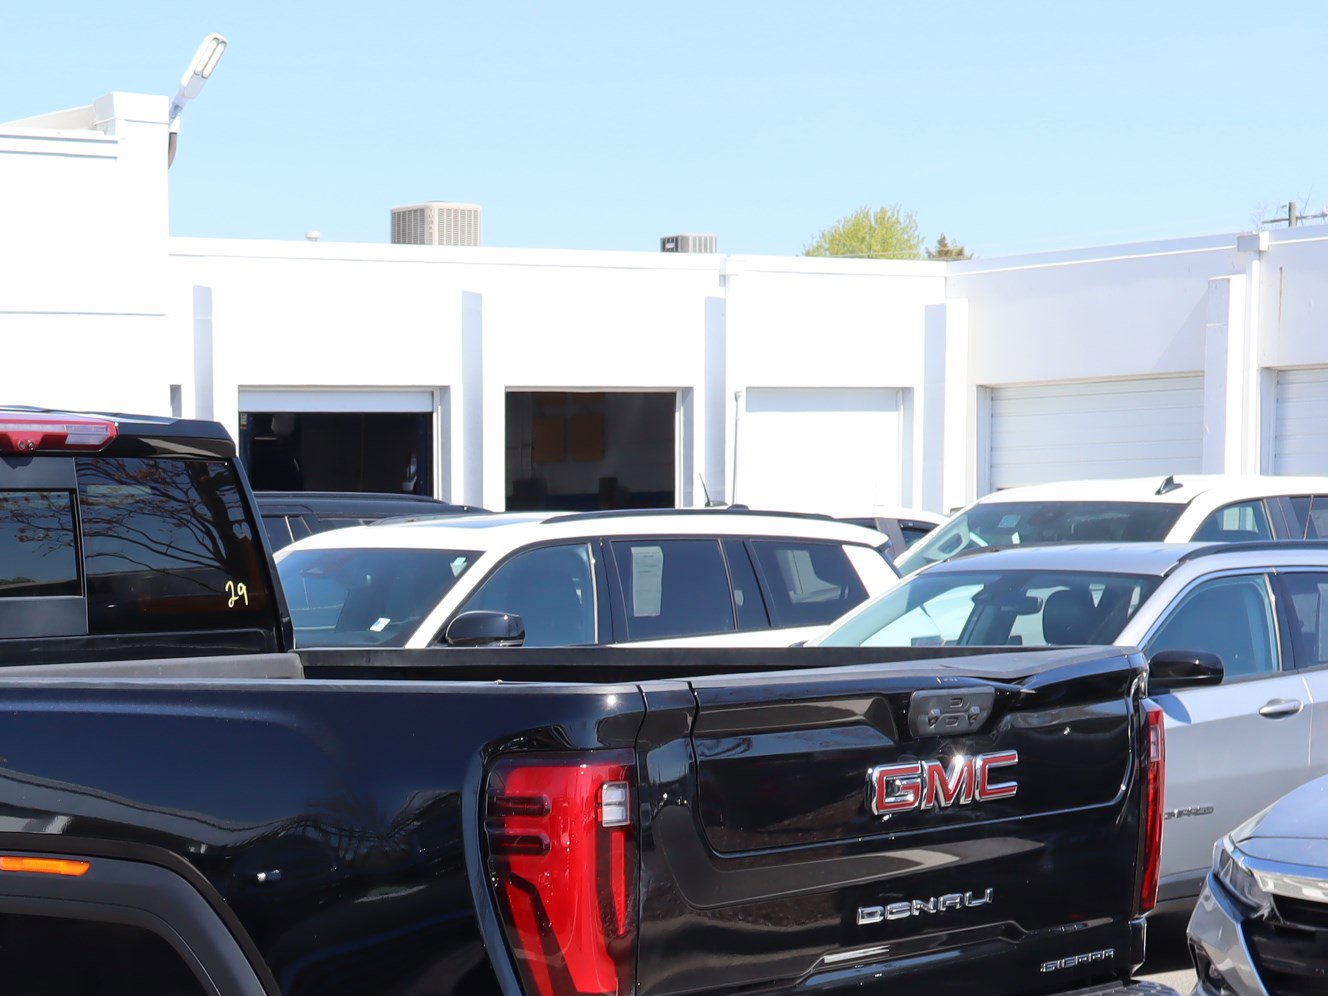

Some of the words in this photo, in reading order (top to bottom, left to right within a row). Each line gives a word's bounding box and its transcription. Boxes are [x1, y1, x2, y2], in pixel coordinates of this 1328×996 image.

[225, 580, 249, 608] 29
[871, 750, 1019, 816] GMC
[857, 887, 994, 926] DENALI
[1040, 948, 1115, 973] SIERRA
